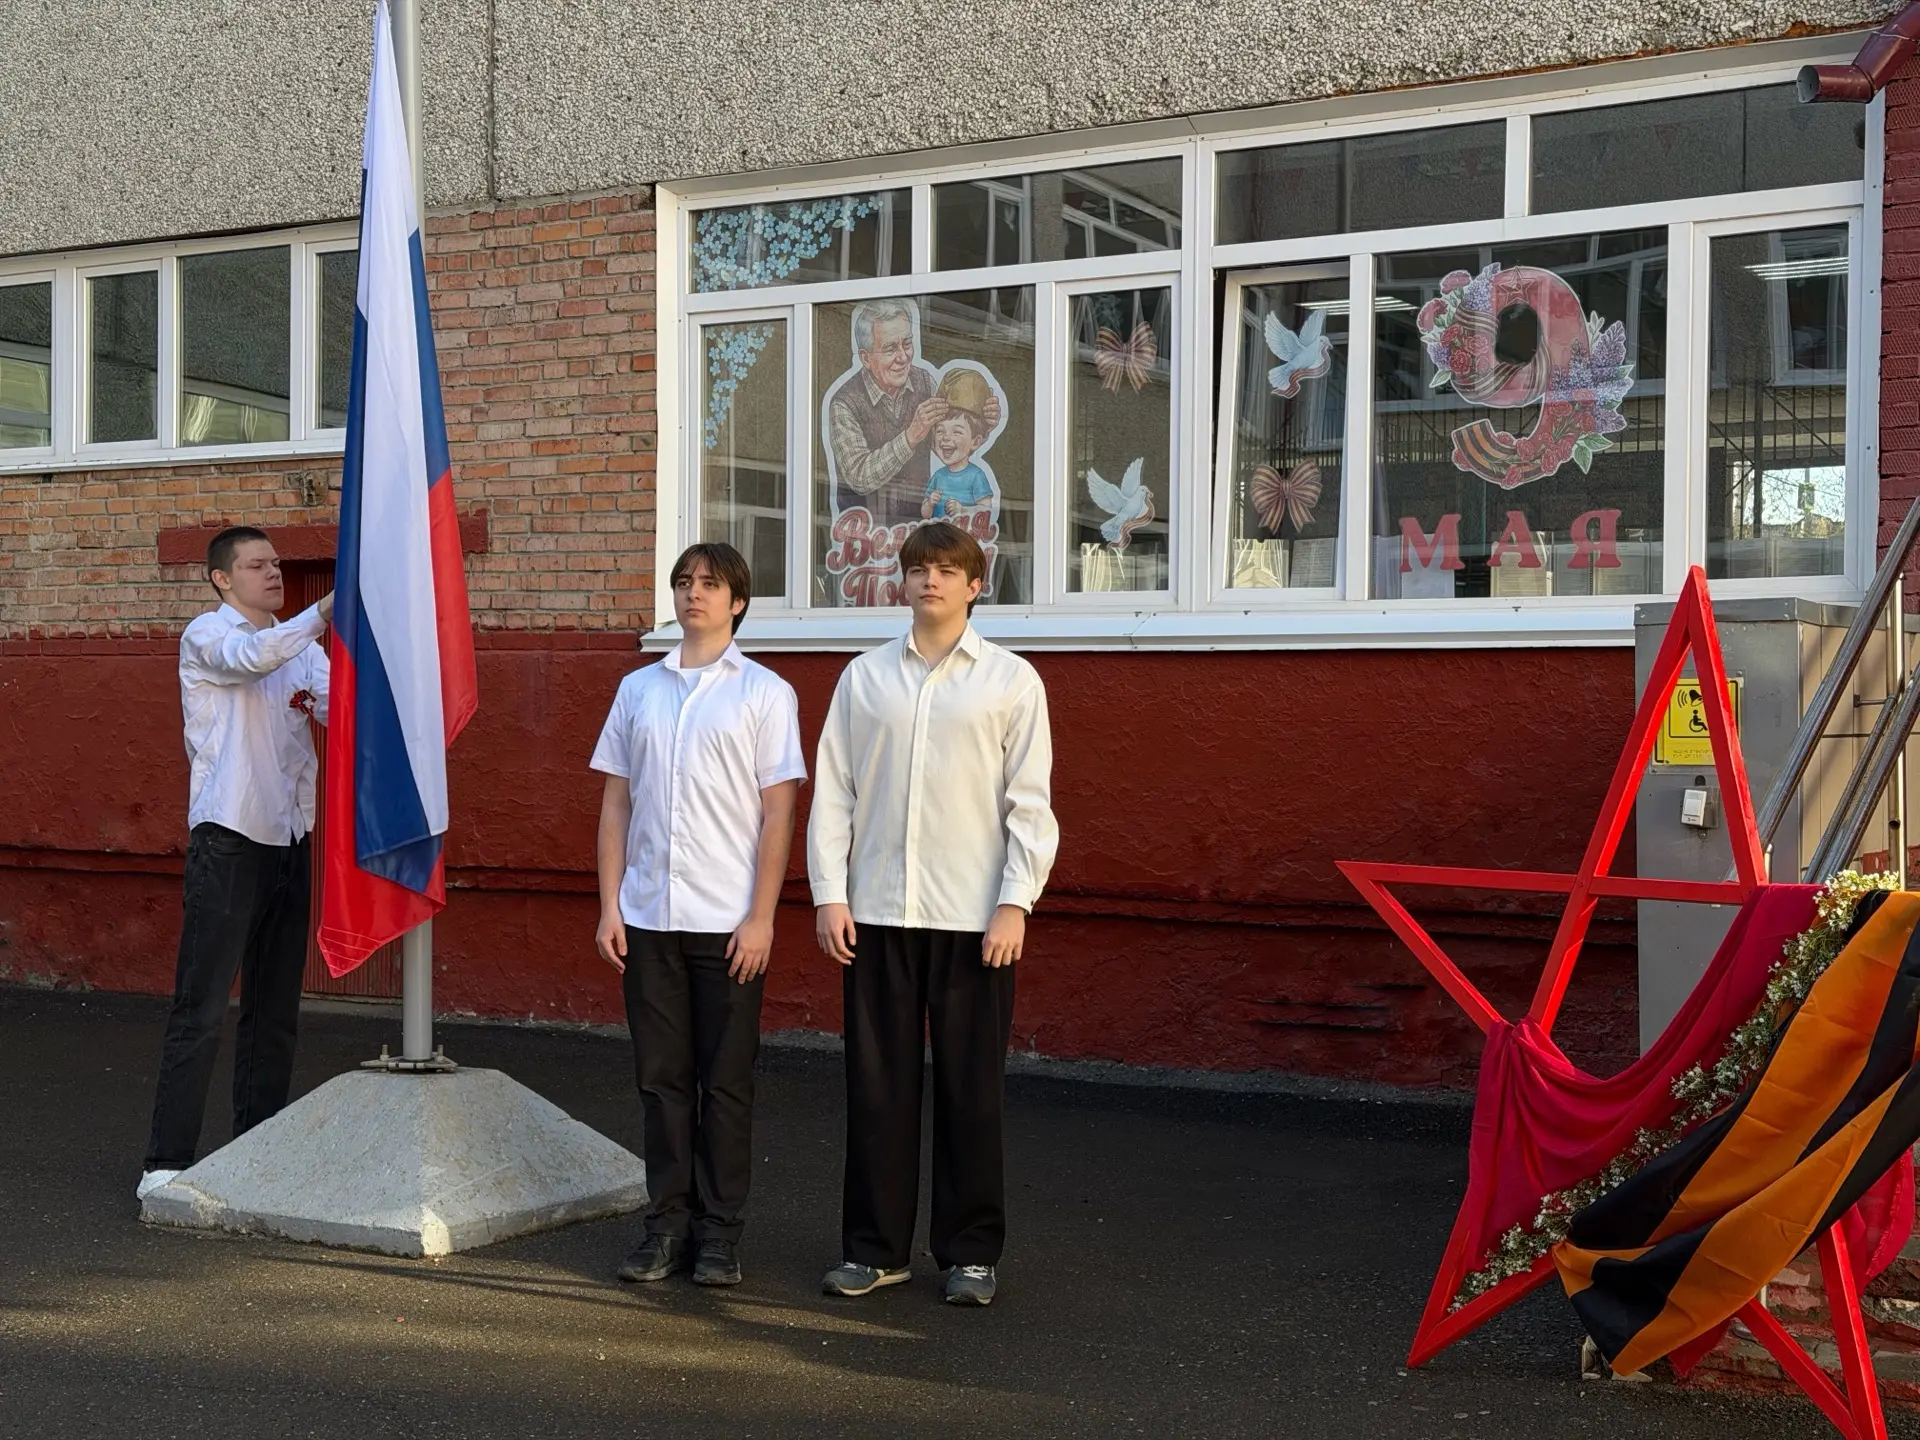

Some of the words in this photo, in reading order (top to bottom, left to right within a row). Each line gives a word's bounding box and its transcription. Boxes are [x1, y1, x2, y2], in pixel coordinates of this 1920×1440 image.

[1447, 265, 1594, 488] 9
[828, 509, 997, 570] Велая
[1400, 509, 1622, 573] МАЯ
